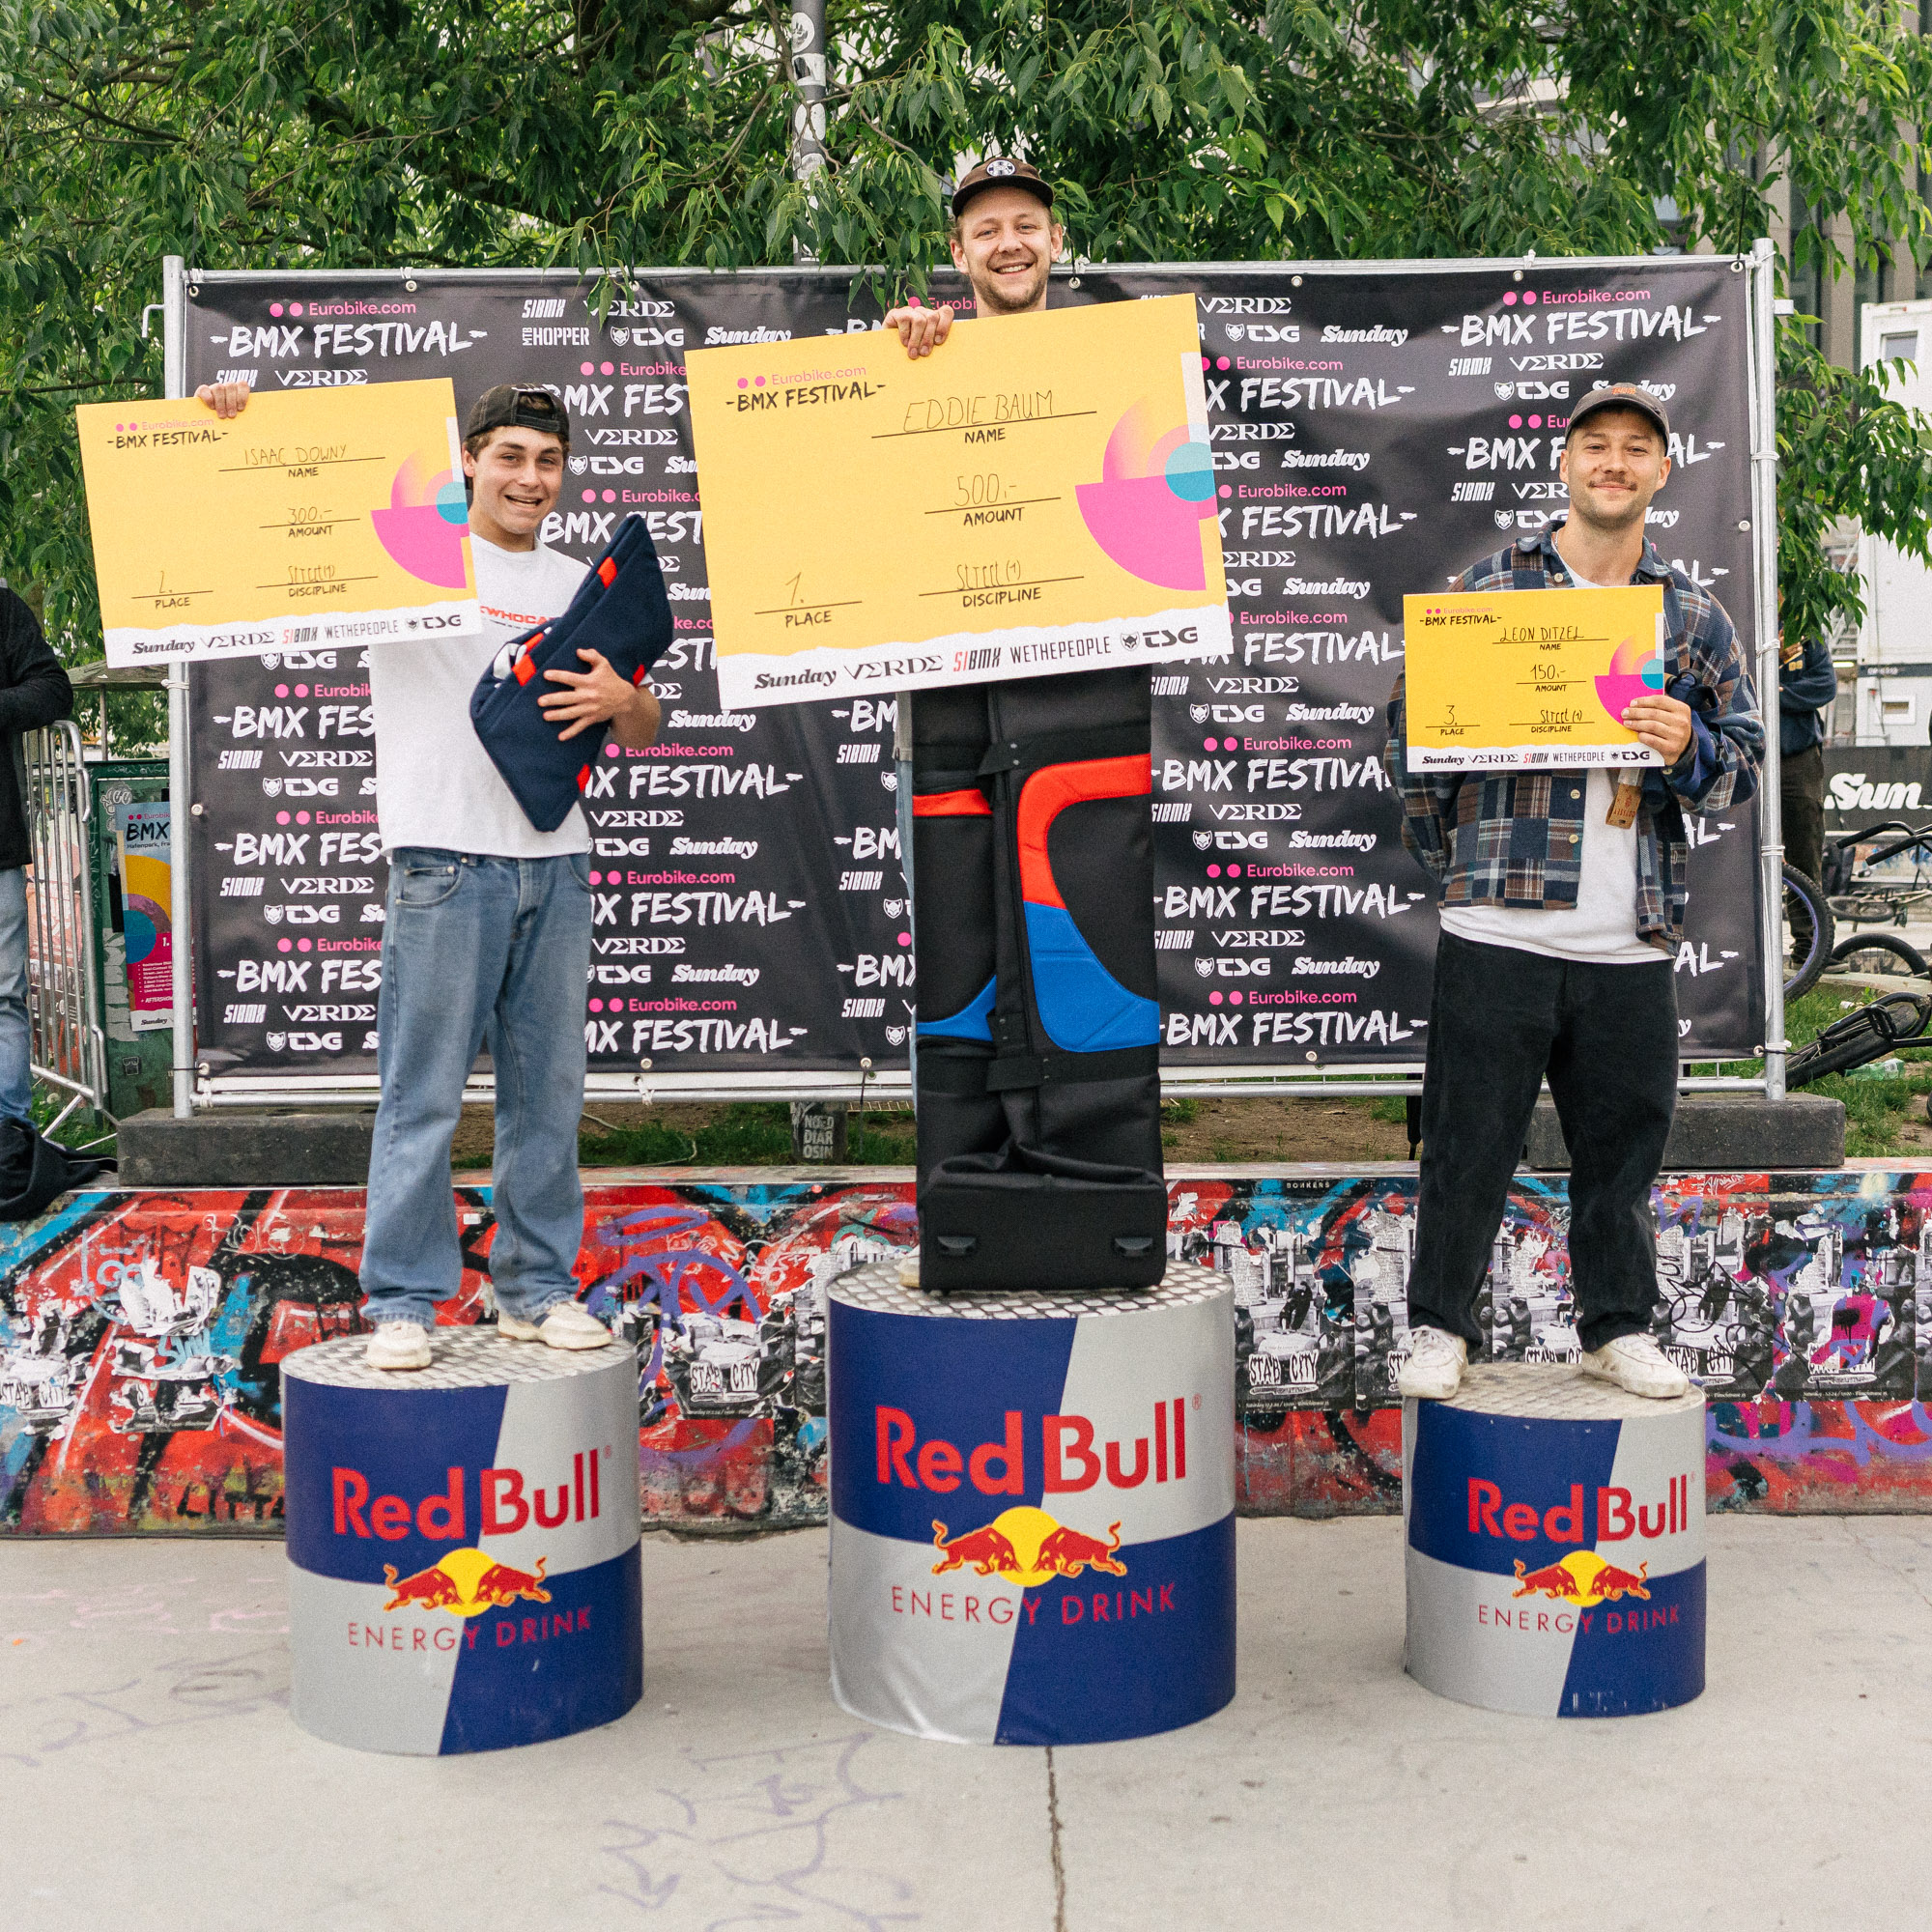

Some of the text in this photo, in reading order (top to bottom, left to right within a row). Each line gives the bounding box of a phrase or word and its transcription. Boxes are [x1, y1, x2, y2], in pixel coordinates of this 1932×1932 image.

[1543, 289, 1651, 304] Eurobike.com
[309, 300, 416, 316] Eurobike.com
[533, 327, 590, 346] HOPPER
[632, 327, 684, 347] TSG
[704, 326, 792, 346] Sunday
[1246, 325, 1408, 347] TSG Sunday
[1236, 356, 1344, 371] Eurobike.com
[771, 365, 867, 385] Eurobike.com
[1516, 381, 1570, 400] TSG
[903, 389, 1053, 433] EDDIE BAUM
[142, 418, 214, 431] Eurobike.com
[964, 427, 1006, 444] NAME
[244, 444, 347, 466] ISAAC DOWNY
[1281, 449, 1371, 471] Sunday
[288, 467, 319, 477] NAME
[589, 456, 643, 474] TSG
[1238, 484, 1347, 498] Eurobike.com
[963, 506, 1024, 526] AMOUNT
[288, 525, 333, 538] AMOUNT
[288, 583, 347, 597] DISCIPLINE
[1283, 577, 1371, 599] Sunday
[155, 597, 190, 610] PLACE
[962, 586, 1042, 609] DISCIPLINE
[785, 611, 833, 628] PLACE
[1240, 610, 1348, 625] Eurobike.com
[1443, 606, 1493, 615] Eurobike.com
[131, 639, 195, 655] Sunday
[325, 621, 399, 639] WETHEPEOPLE
[423, 613, 462, 630] TSG
[1500, 626, 1584, 643] LEON DITZEL
[1539, 642, 1562, 651] NAME
[284, 650, 337, 669] TSG
[753, 667, 838, 691] Sunday
[1010, 636, 1112, 665] WETHEPEOPLE
[1142, 626, 1199, 648] TSG
[1535, 684, 1567, 693] AMOUNT
[668, 709, 756, 732] Sunday
[1211, 702, 1375, 724] TSG Sunday
[1439, 727, 1464, 736] PLACE
[1531, 724, 1573, 734] DISCIPLINE
[1243, 736, 1351, 751] Eurobike.com
[1422, 754, 1464, 765] Sunday
[1552, 751, 1605, 763] WETHEPEOPLE
[1622, 751, 1650, 761] TSG
[284, 778, 338, 796] TSG
[127, 822, 170, 841] BMX
[595, 837, 757, 860] TSG Sunday
[1214, 830, 1378, 852] TSG Sunday
[627, 870, 735, 885] Eurobike.com
[1247, 863, 1354, 878] Eurobike.com
[286, 905, 340, 923] TSG
[596, 964, 760, 987] TSG Sunday
[1216, 956, 1380, 979] TSG Sunday
[629, 998, 737, 1012] Eurobike.com
[1249, 990, 1357, 1005] Eurobike.com
[141, 1017, 167, 1026] Sunday
[288, 1032, 342, 1051] TSG
[1249, 1350, 1319, 1384] STAB CITY
[875, 1397, 1186, 1496] Red Bull
[332, 1448, 599, 1541] Red Bull
[1467, 1473, 1687, 1544] Red Bull
[892, 1582, 1176, 1626] ENERGY DRINK
[1478, 1604, 1680, 1634] ENERGY DRINK
[348, 1605, 591, 1652] ENERGY DRINK
